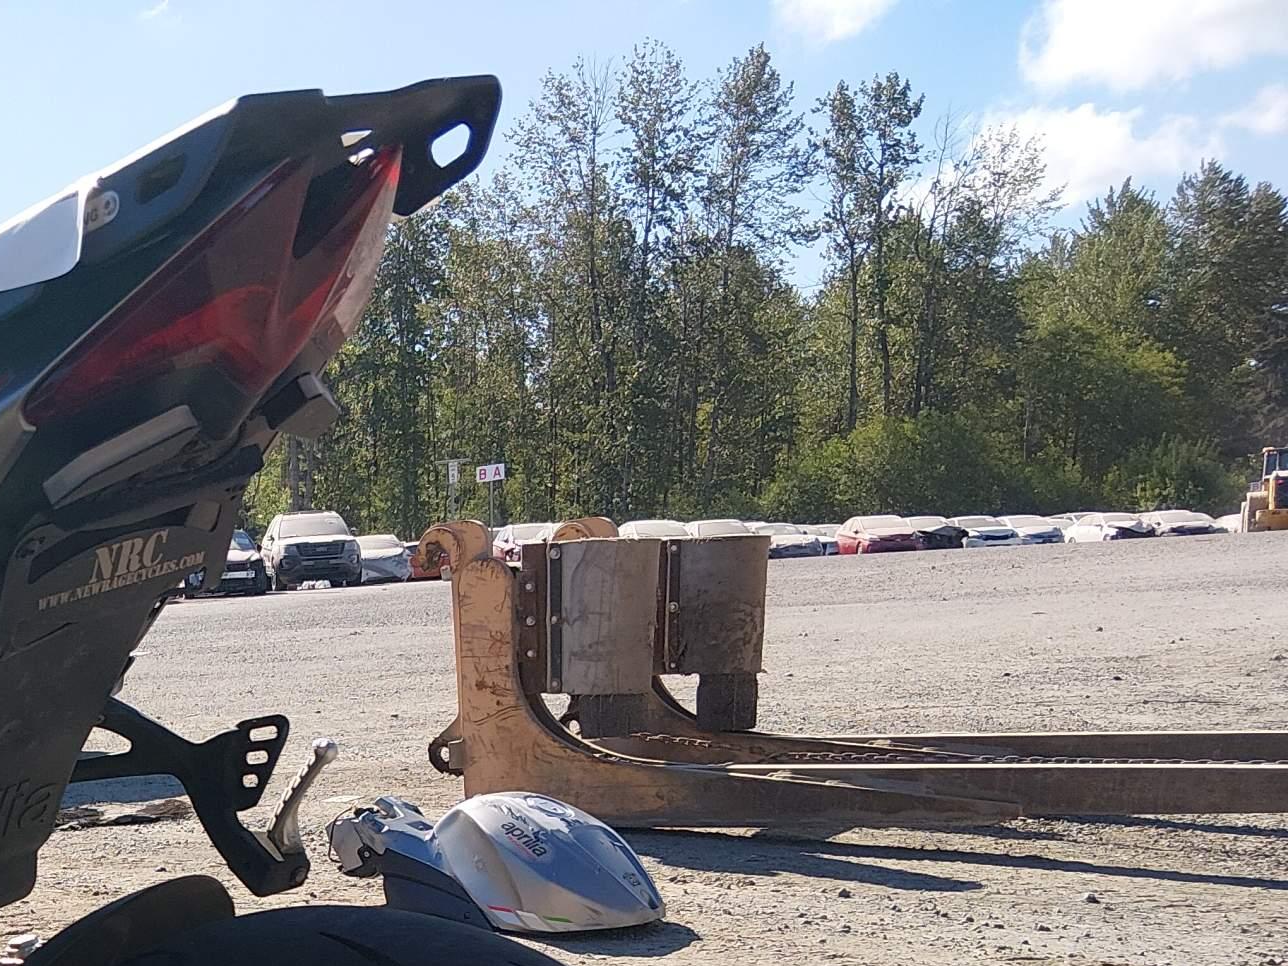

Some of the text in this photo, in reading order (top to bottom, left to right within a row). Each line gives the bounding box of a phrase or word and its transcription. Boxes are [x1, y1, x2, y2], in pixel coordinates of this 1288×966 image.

[478, 466, 502, 480] B A
[89, 529, 169, 584] NRC
[38, 551, 205, 611] WWW.NEWRAGECYCLES.COM
[500, 820, 548, 858] aprilia
